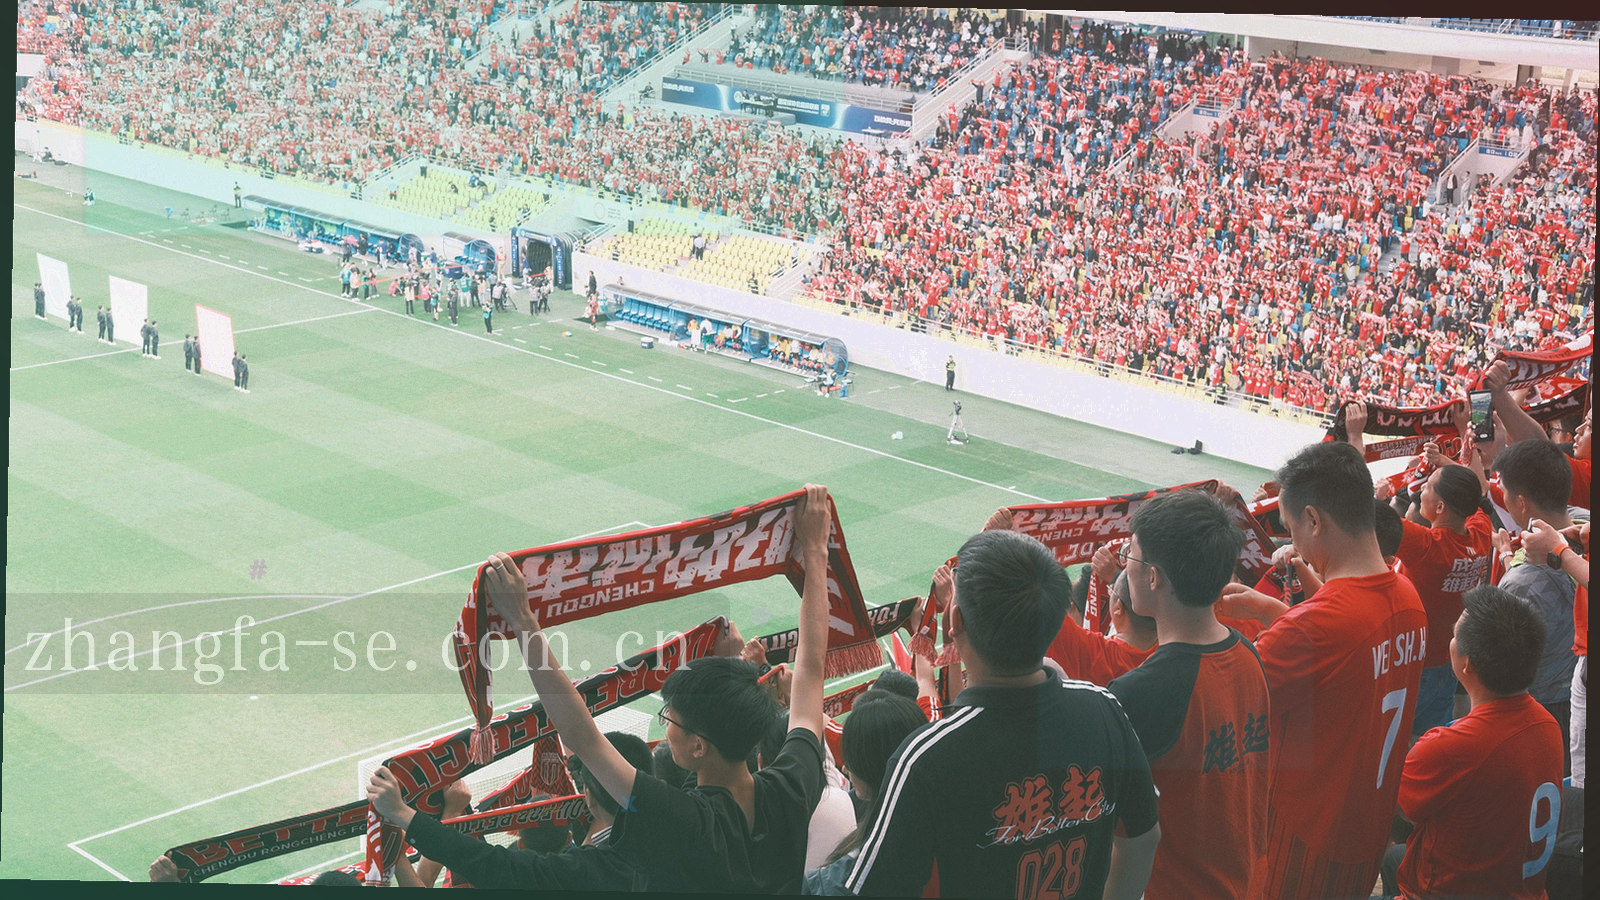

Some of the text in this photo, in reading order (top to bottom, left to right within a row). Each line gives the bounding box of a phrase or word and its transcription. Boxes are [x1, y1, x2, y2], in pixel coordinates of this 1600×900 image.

[545, 579, 655, 620] CHENGDU
[1376, 688, 1407, 790] 7
[176, 804, 368, 868] BETTE
[992, 763, 1105, 845] 雄起
[1522, 782, 1562, 880] 9
[1015, 834, 1088, 900] 028
